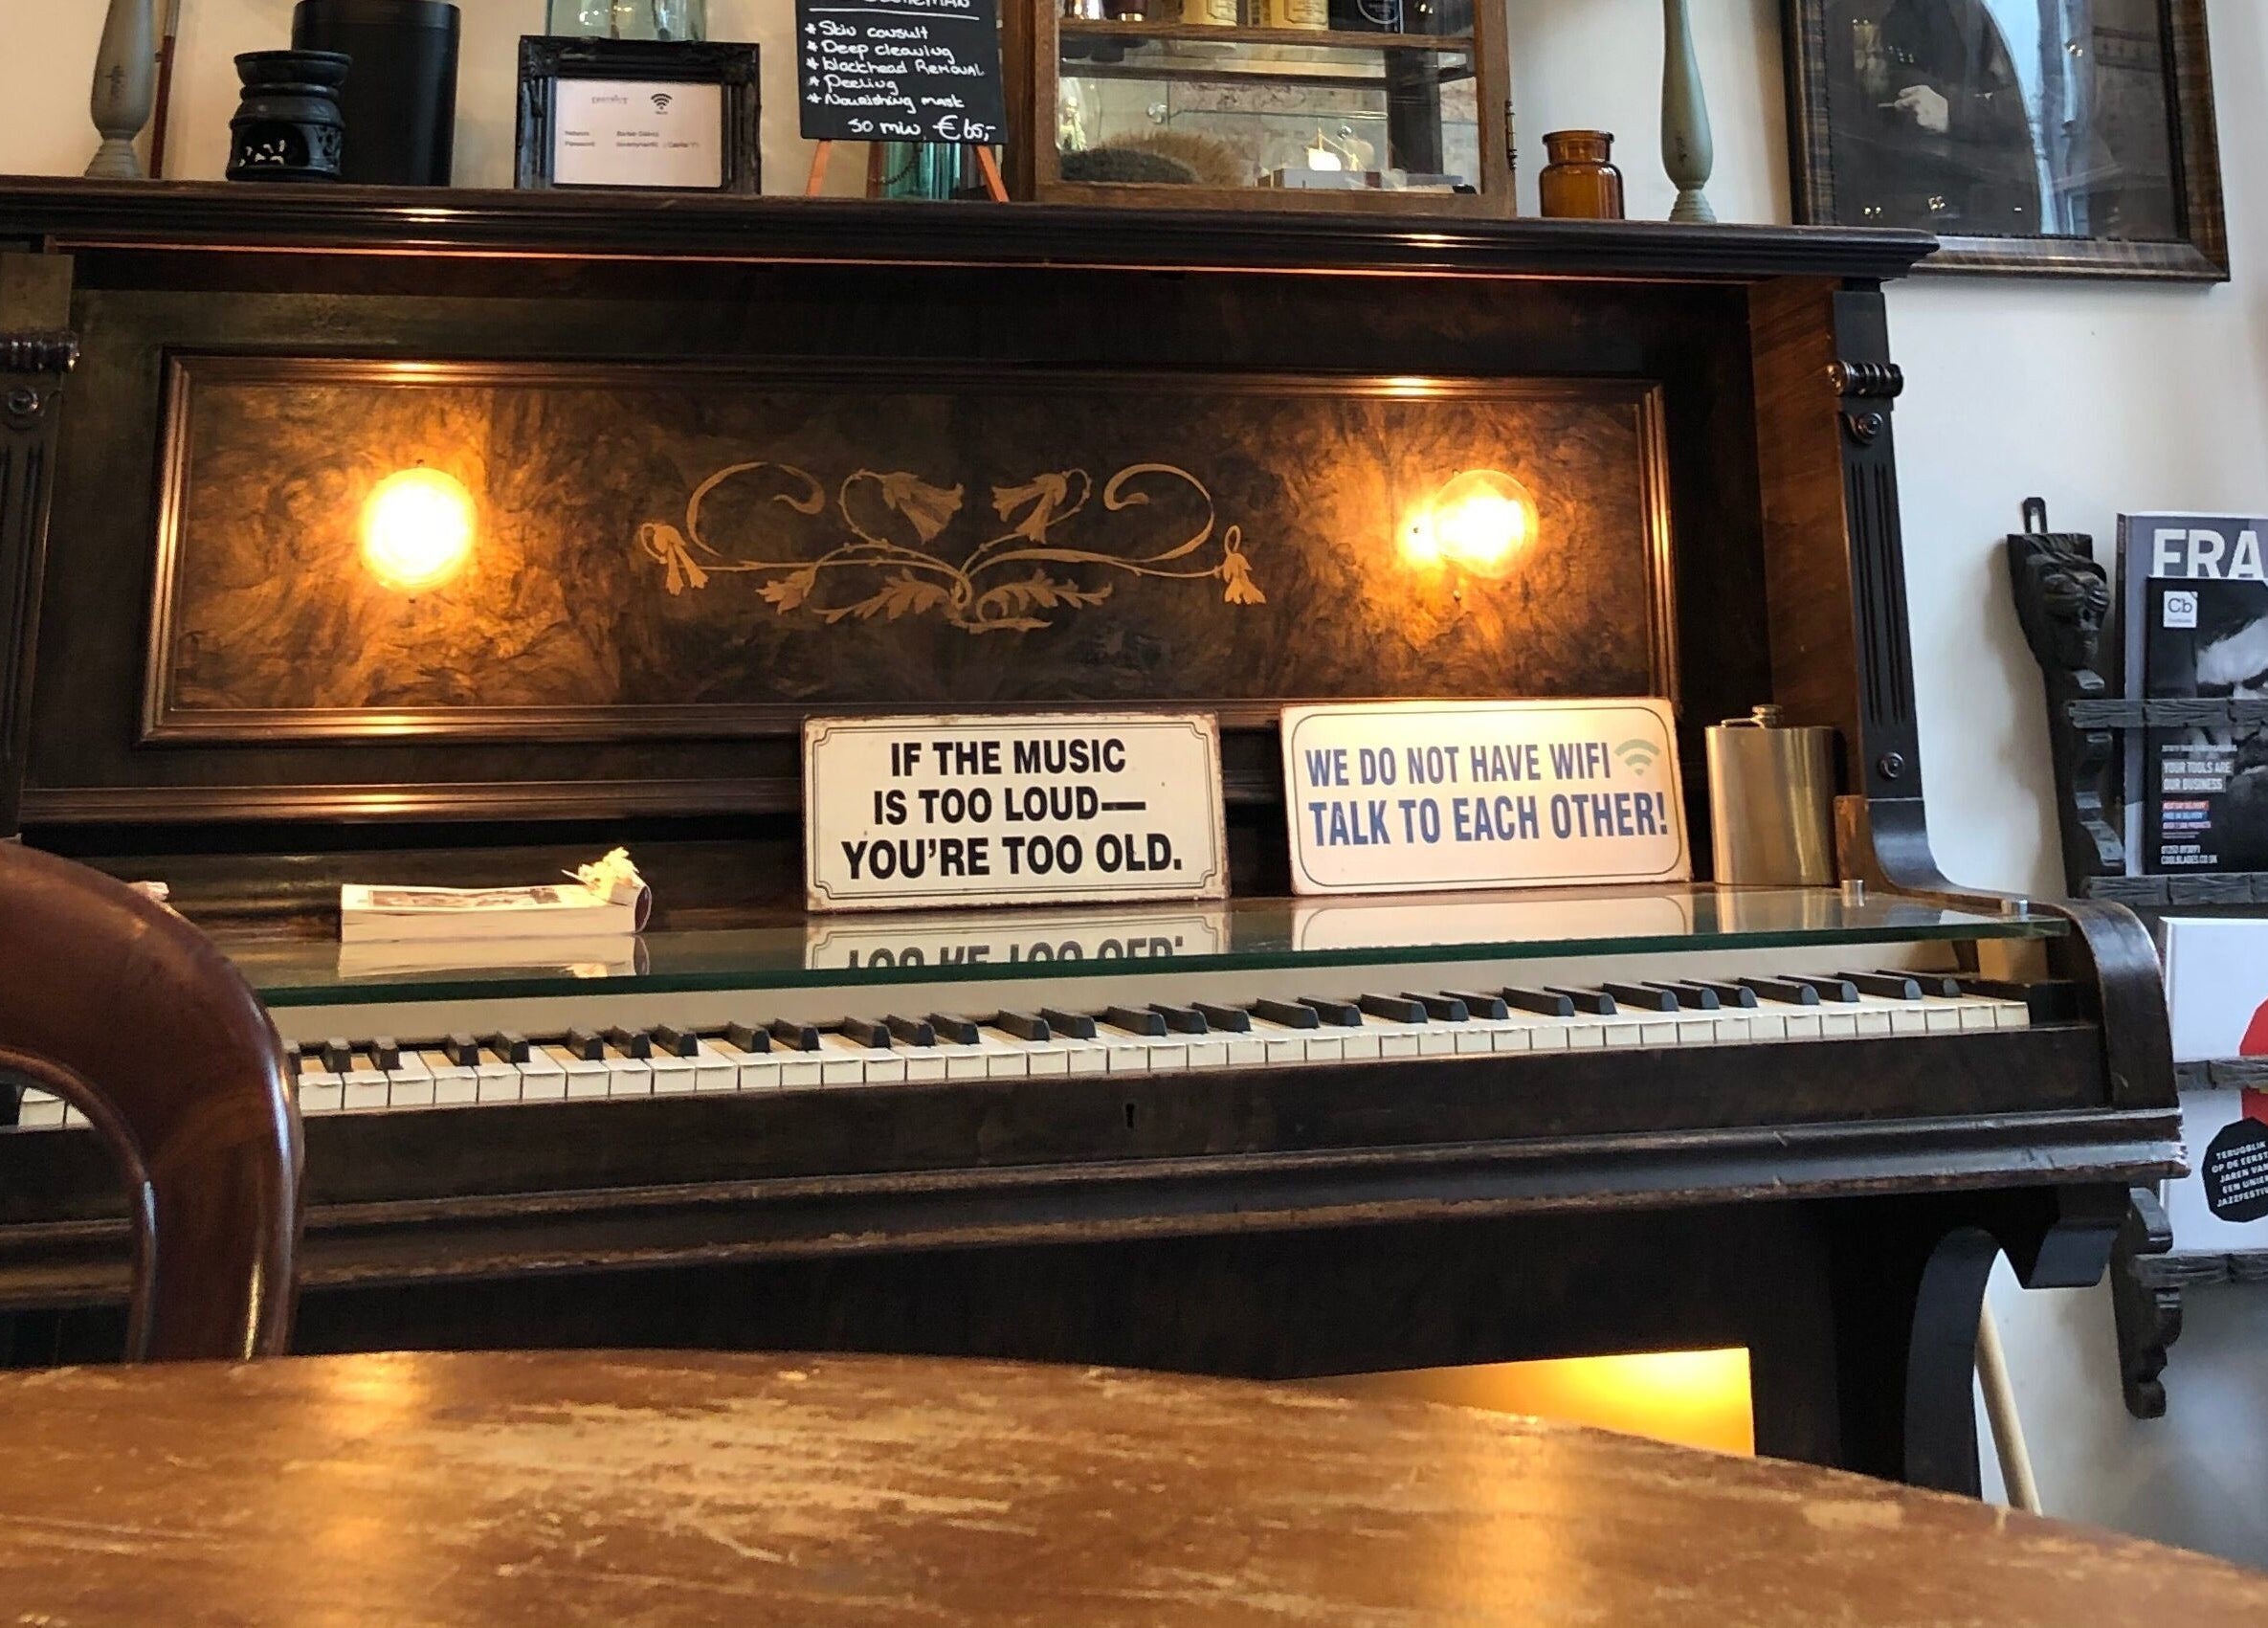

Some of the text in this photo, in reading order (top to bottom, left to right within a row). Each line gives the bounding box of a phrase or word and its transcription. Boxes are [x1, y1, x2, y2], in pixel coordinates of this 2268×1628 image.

[819, 20, 928, 39] Skin consult
[821, 39, 955, 64] Deep cleaning
[824, 74, 899, 95] Peeling
[825, 93, 965, 114] Nourishing mask
[879, 122, 921, 135] min
[2168, 597, 2193, 613] Cb
[891, 738, 1125, 776] IF THE MUSIC
[1305, 742, 1612, 787] WE DO NOT HAVE WIFI
[874, 789, 907, 825] IS
[918, 787, 992, 824] TOO
[1308, 792, 1668, 846] TALK TO EACH OTHER!
[841, 833, 1183, 880] YOU'RE TOO OLD.
[2212, 1164, 2225, 1173] OP
[2226, 1159, 2239, 1170] DE
